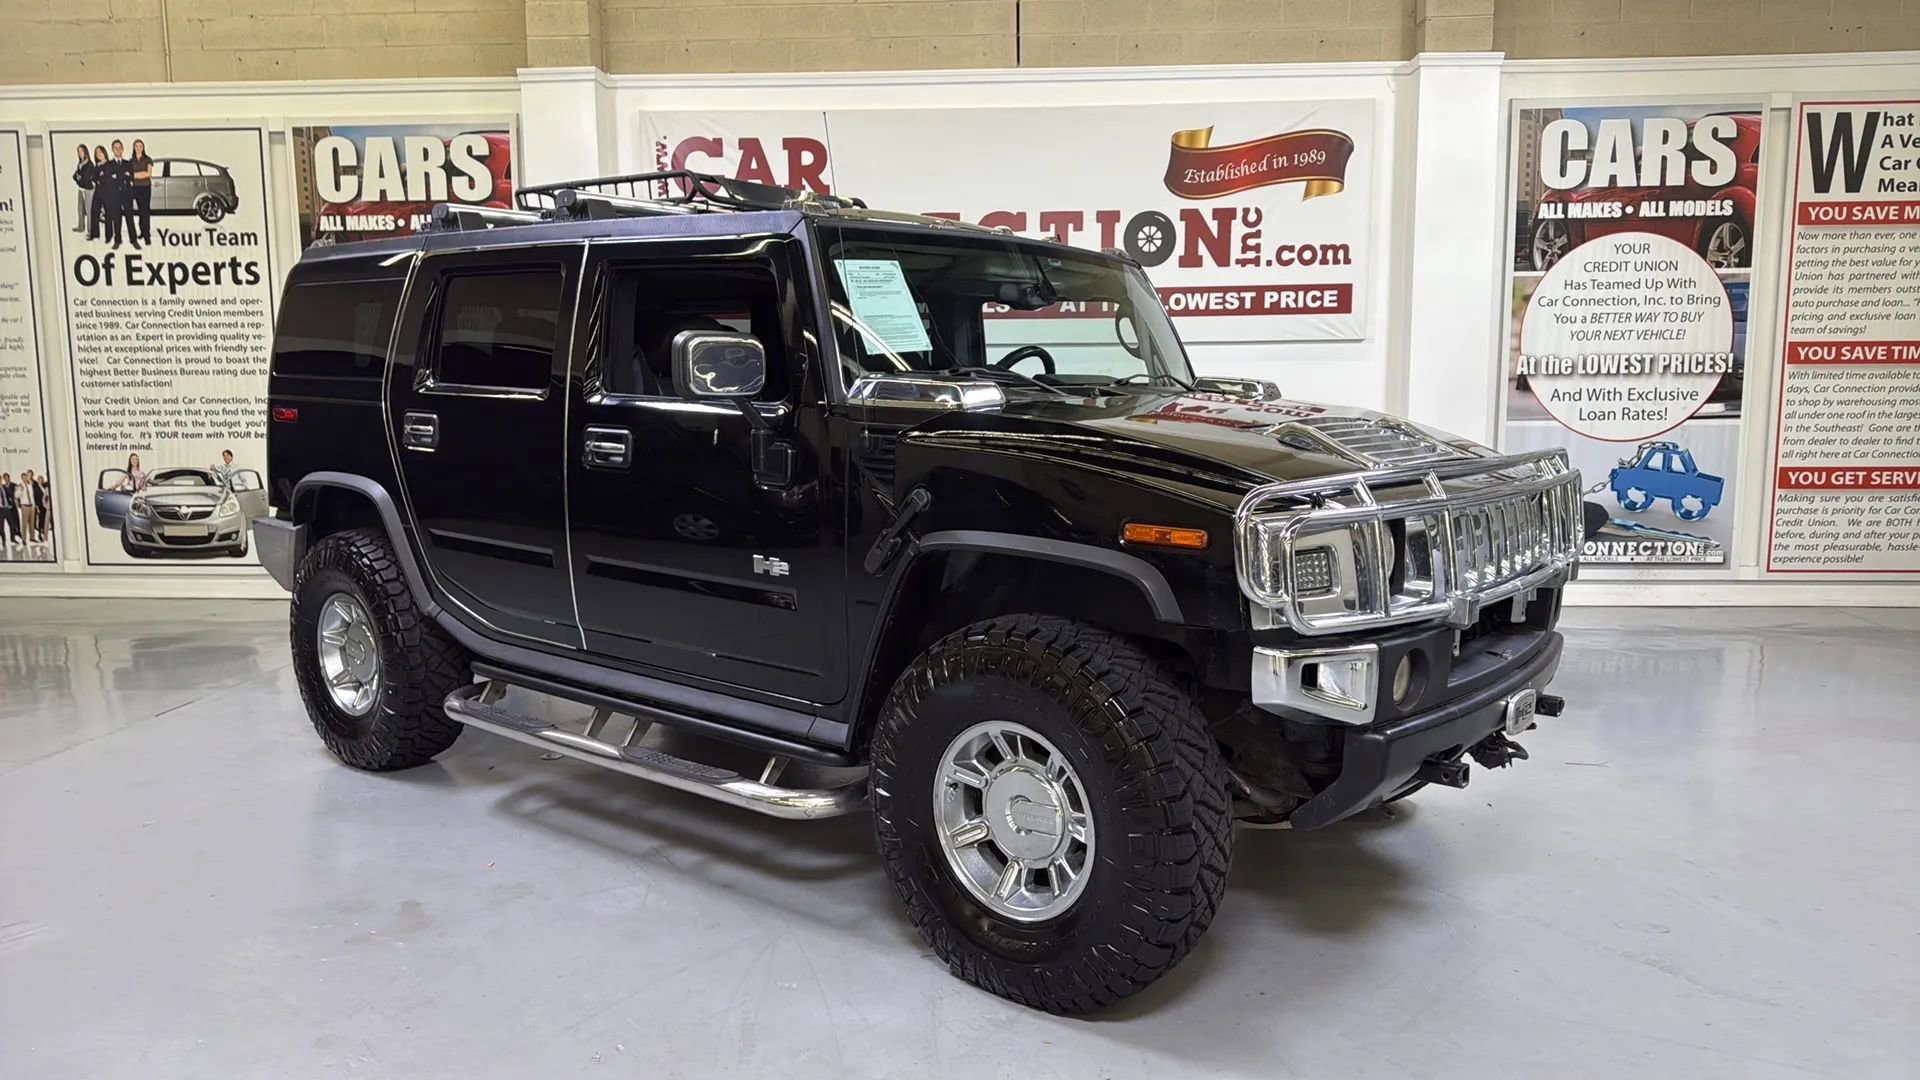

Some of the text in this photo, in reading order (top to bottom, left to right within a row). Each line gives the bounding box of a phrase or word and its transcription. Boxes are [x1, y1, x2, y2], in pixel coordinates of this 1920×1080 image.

[1880, 134, 1894, 149] A
[1541, 116, 1738, 190] CARS
[314, 134, 493, 204] CARS
[671, 136, 831, 198] CAR
[1184, 149, 1327, 184] Established in 1989
[1879, 156, 1912, 171] Car
[1878, 178, 1920, 193] Mea
[1538, 199, 1734, 220] ALL MAKES ALL MODELS
[1808, 206, 1848, 221] YOU
[1852, 205, 1900, 221] SAVE
[319, 215, 344, 232] ALL
[346, 214, 396, 232] MAKES
[156, 228, 259, 247] Your Team
[1797, 231, 1820, 240] Now
[1822, 232, 1847, 240] more
[1850, 231, 1872, 240] than
[1874, 232, 1896, 242] ever,
[1265, 242, 1352, 268] .com
[1613, 243, 1651, 255] YOUR
[73, 252, 262, 295] Of Experts
[1583, 260, 1679, 274] CREDIT UNION
[1564, 277, 1697, 292] Has Teamed Up With
[1792, 285, 1892, 297] provide its members
[74, 297, 86, 306] Car
[90, 297, 138, 306] Connection
[142, 297, 148, 306] is
[158, 297, 184, 307] family
[188, 297, 216, 305] owned
[220, 297, 236, 305] and
[240, 298, 262, 307] oper-
[1263, 289, 1339, 309] PRICE
[1537, 294, 1721, 308] Car Connection, Inc. to Bring
[1553, 311, 1705, 324] You a BETTER WAY TO BUY
[1790, 311, 1916, 323] pricing and exclusive loan
[76, 321, 96, 330] since
[98, 321, 122, 330] 1989.
[126, 321, 138, 330] Car
[140, 321, 190, 329] Connection
[192, 321, 206, 329] has
[208, 321, 237, 329] earned
[246, 322, 264, 331] rep-
[1790, 325, 1866, 336] team of savings!
[1569, 329, 1686, 341] YOUR NEXT VEHICLE!
[78, 344, 102, 353] hicles
[104, 344, 112, 353] at
[114, 344, 162, 355] exceptional
[166, 344, 190, 354] prices
[192, 344, 212, 352] with
[214, 343, 248, 354] friendly
[1797, 346, 1836, 361] YOU
[1840, 346, 1888, 360] SAVE
[1516, 352, 1734, 375] At the LOWEST PRICES!
[80, 367, 268, 378] highest Better Business Bureau rating due to
[1788, 370, 1911, 380] With limited time available
[1550, 387, 1700, 402] And With Exclusive
[1786, 397, 1896, 409] to shop by warehousing
[82, 408, 104, 417] work
[106, 408, 126, 417] hard
[128, 408, 136, 417] to
[138, 408, 162, 416] make
[184, 408, 202, 416] that
[204, 409, 220, 418] you
[222, 407, 238, 416] find
[240, 407, 254, 416] the
[1578, 407, 1668, 422] Loan Rates!
[86, 442, 152, 451] interest in mind.
[1787, 471, 1827, 485] YOU
[1831, 471, 1867, 485] GET
[1776, 518, 1912, 527] Credit Union. We are BOTH
[1581, 541, 1701, 557] ONNECTION
[752, 554, 790, 577] H2
[1772, 554, 1864, 566] experience possible!
